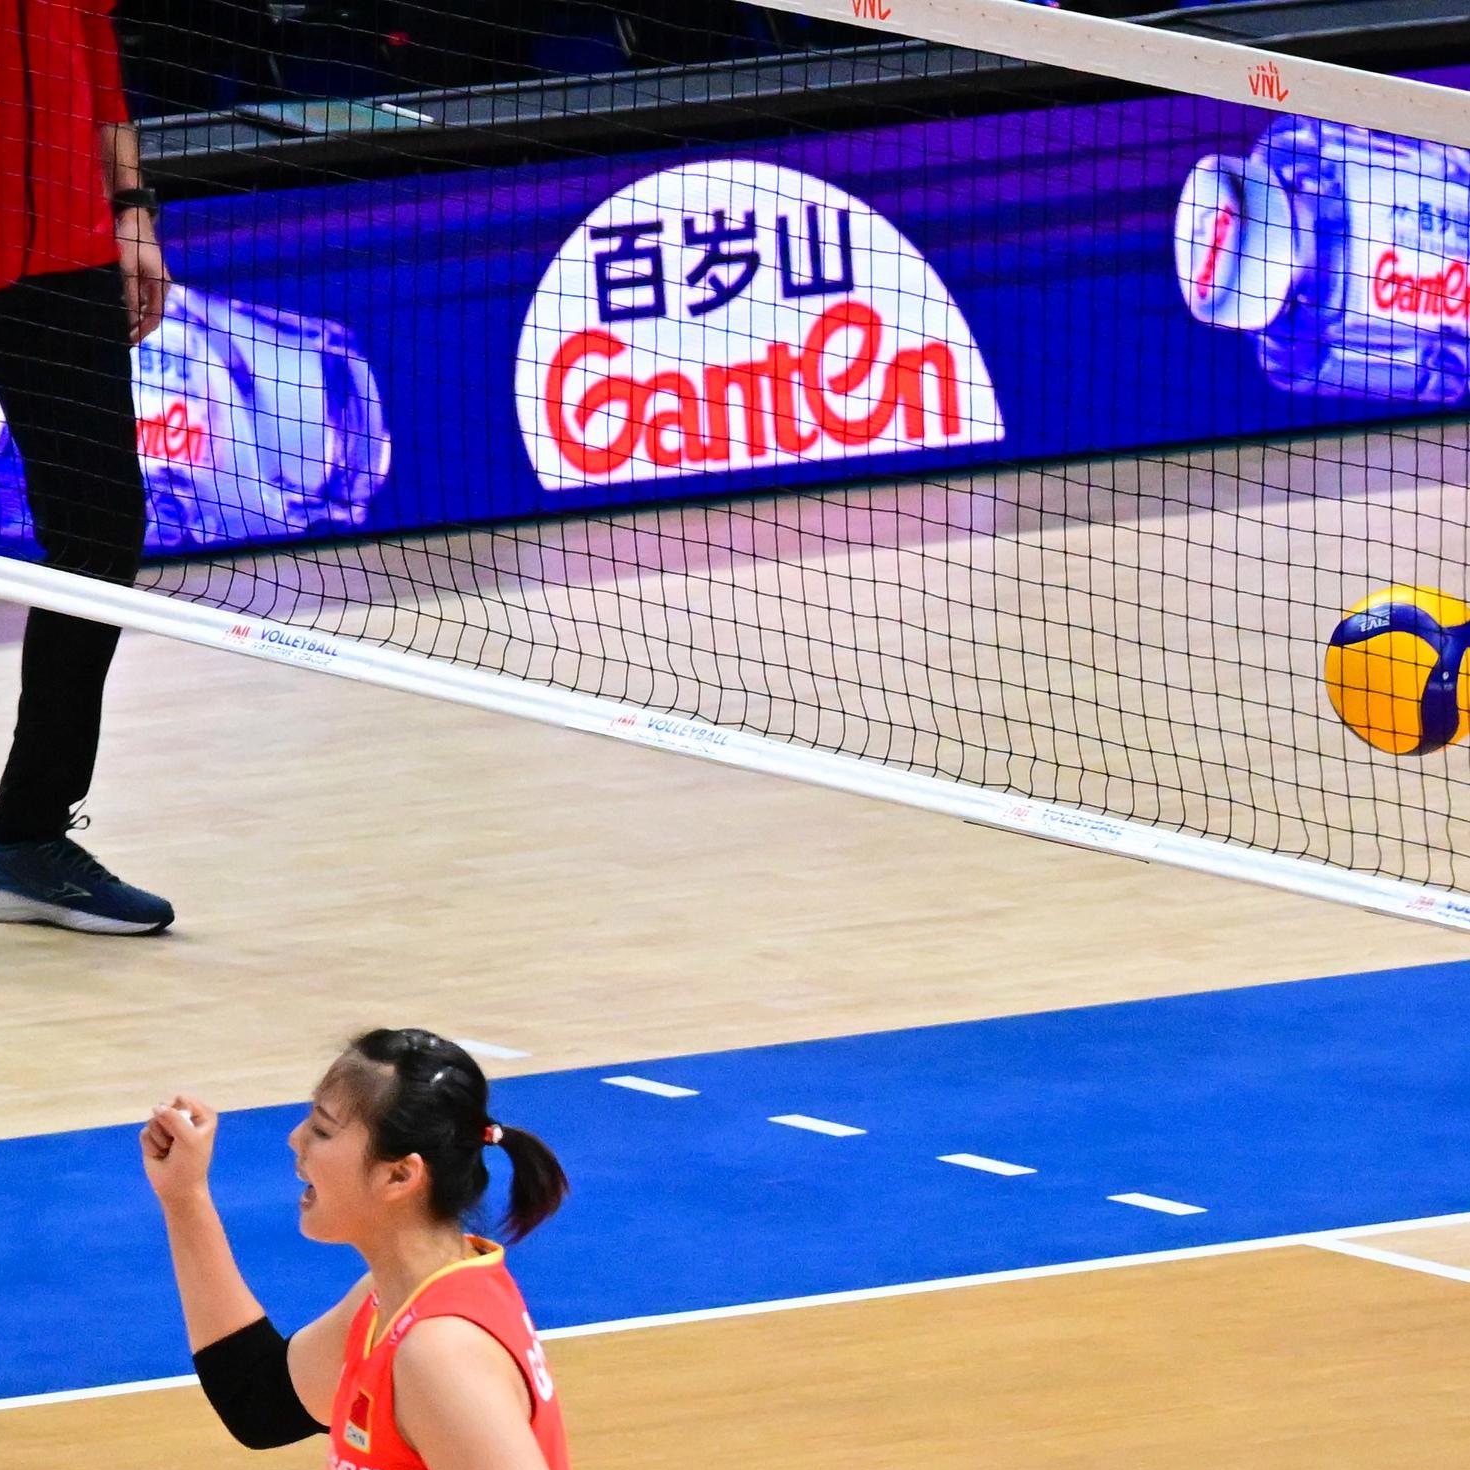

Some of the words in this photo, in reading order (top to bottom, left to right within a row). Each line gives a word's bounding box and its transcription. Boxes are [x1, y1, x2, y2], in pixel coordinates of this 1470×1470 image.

[1248, 61, 1289, 102] VNL
[589, 204, 854, 323] 百岁山
[1374, 250, 1470, 319] Gante
[261, 628, 338, 657] VOLLEYBALL
